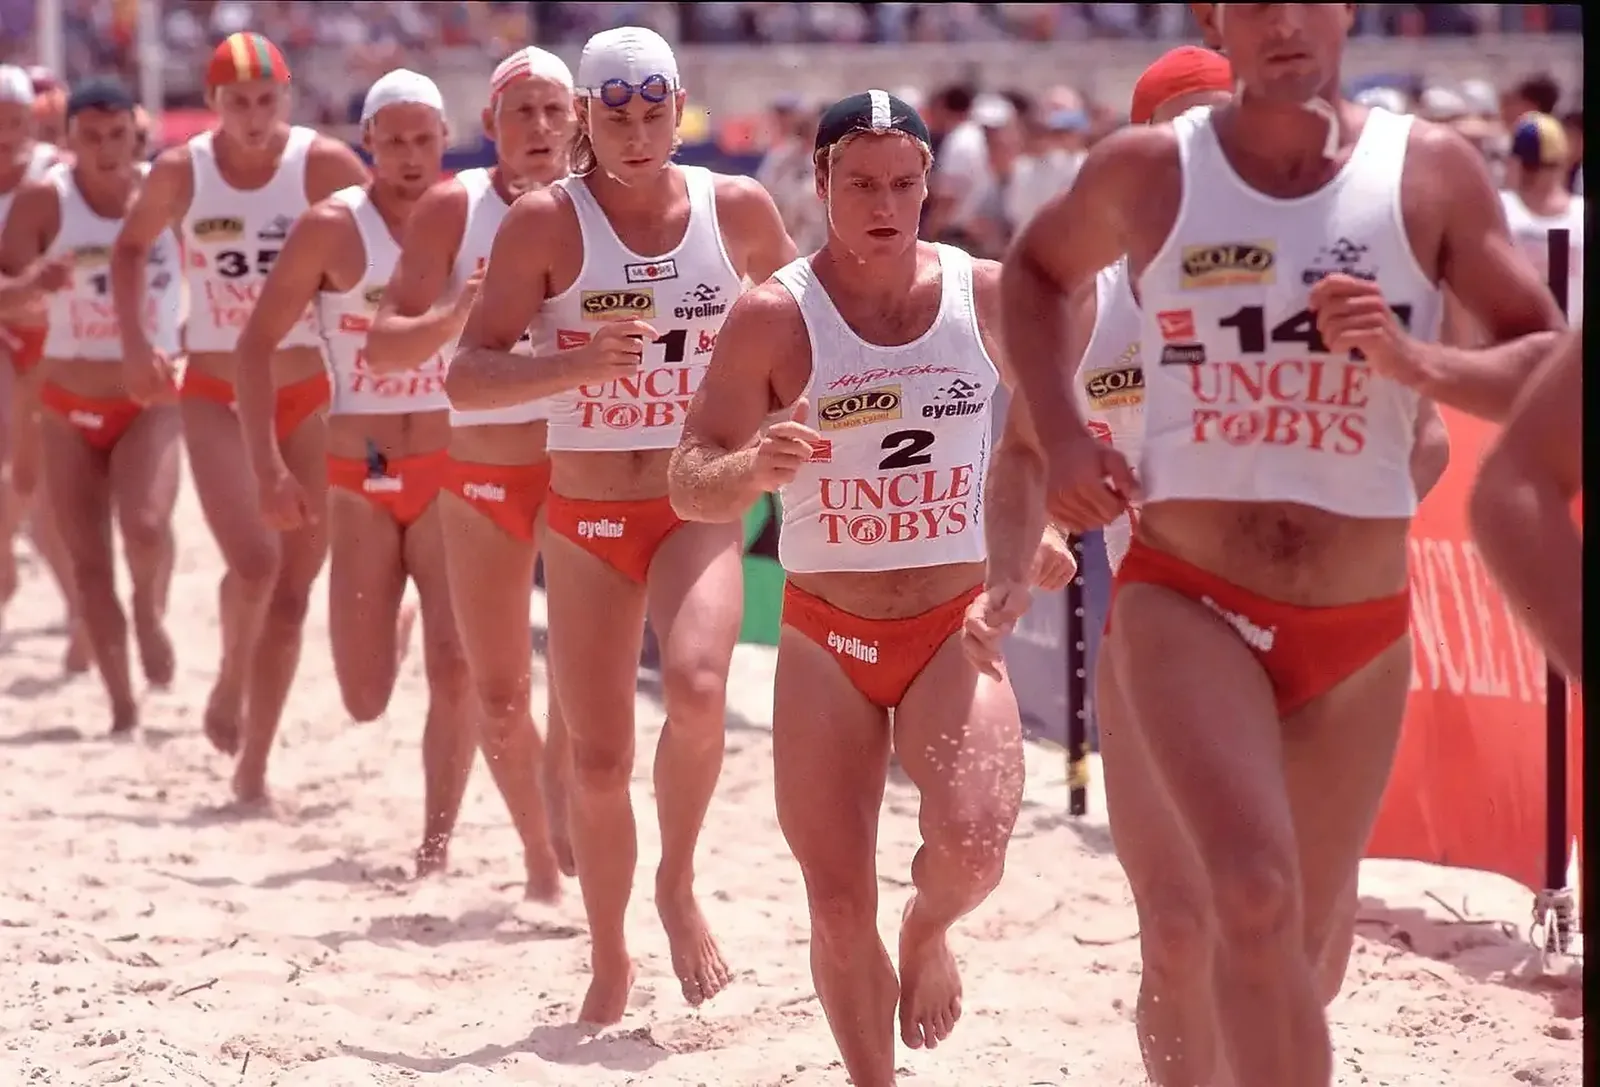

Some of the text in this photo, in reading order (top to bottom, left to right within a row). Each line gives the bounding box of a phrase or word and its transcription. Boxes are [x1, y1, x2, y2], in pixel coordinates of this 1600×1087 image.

[215, 249, 280, 278] 35
[1185, 246, 1271, 276] SOLO
[585, 293, 651, 313] SOLO
[674, 302, 726, 320] eyeline
[578, 367, 709, 399] UNCL
[1089, 370, 1143, 396] SOL
[1188, 359, 1371, 409] UNCLE
[577, 400, 691, 430] TOB
[825, 394, 897, 420] SOLO
[922, 400, 984, 420] eyeline
[1191, 405, 1367, 455] TOBYS
[878, 429, 936, 470] 2
[819, 463, 974, 511] UNCLE
[577, 518, 624, 538] eyeline
[819, 501, 968, 545] TOBYS
[827, 630, 878, 664] eyeline
